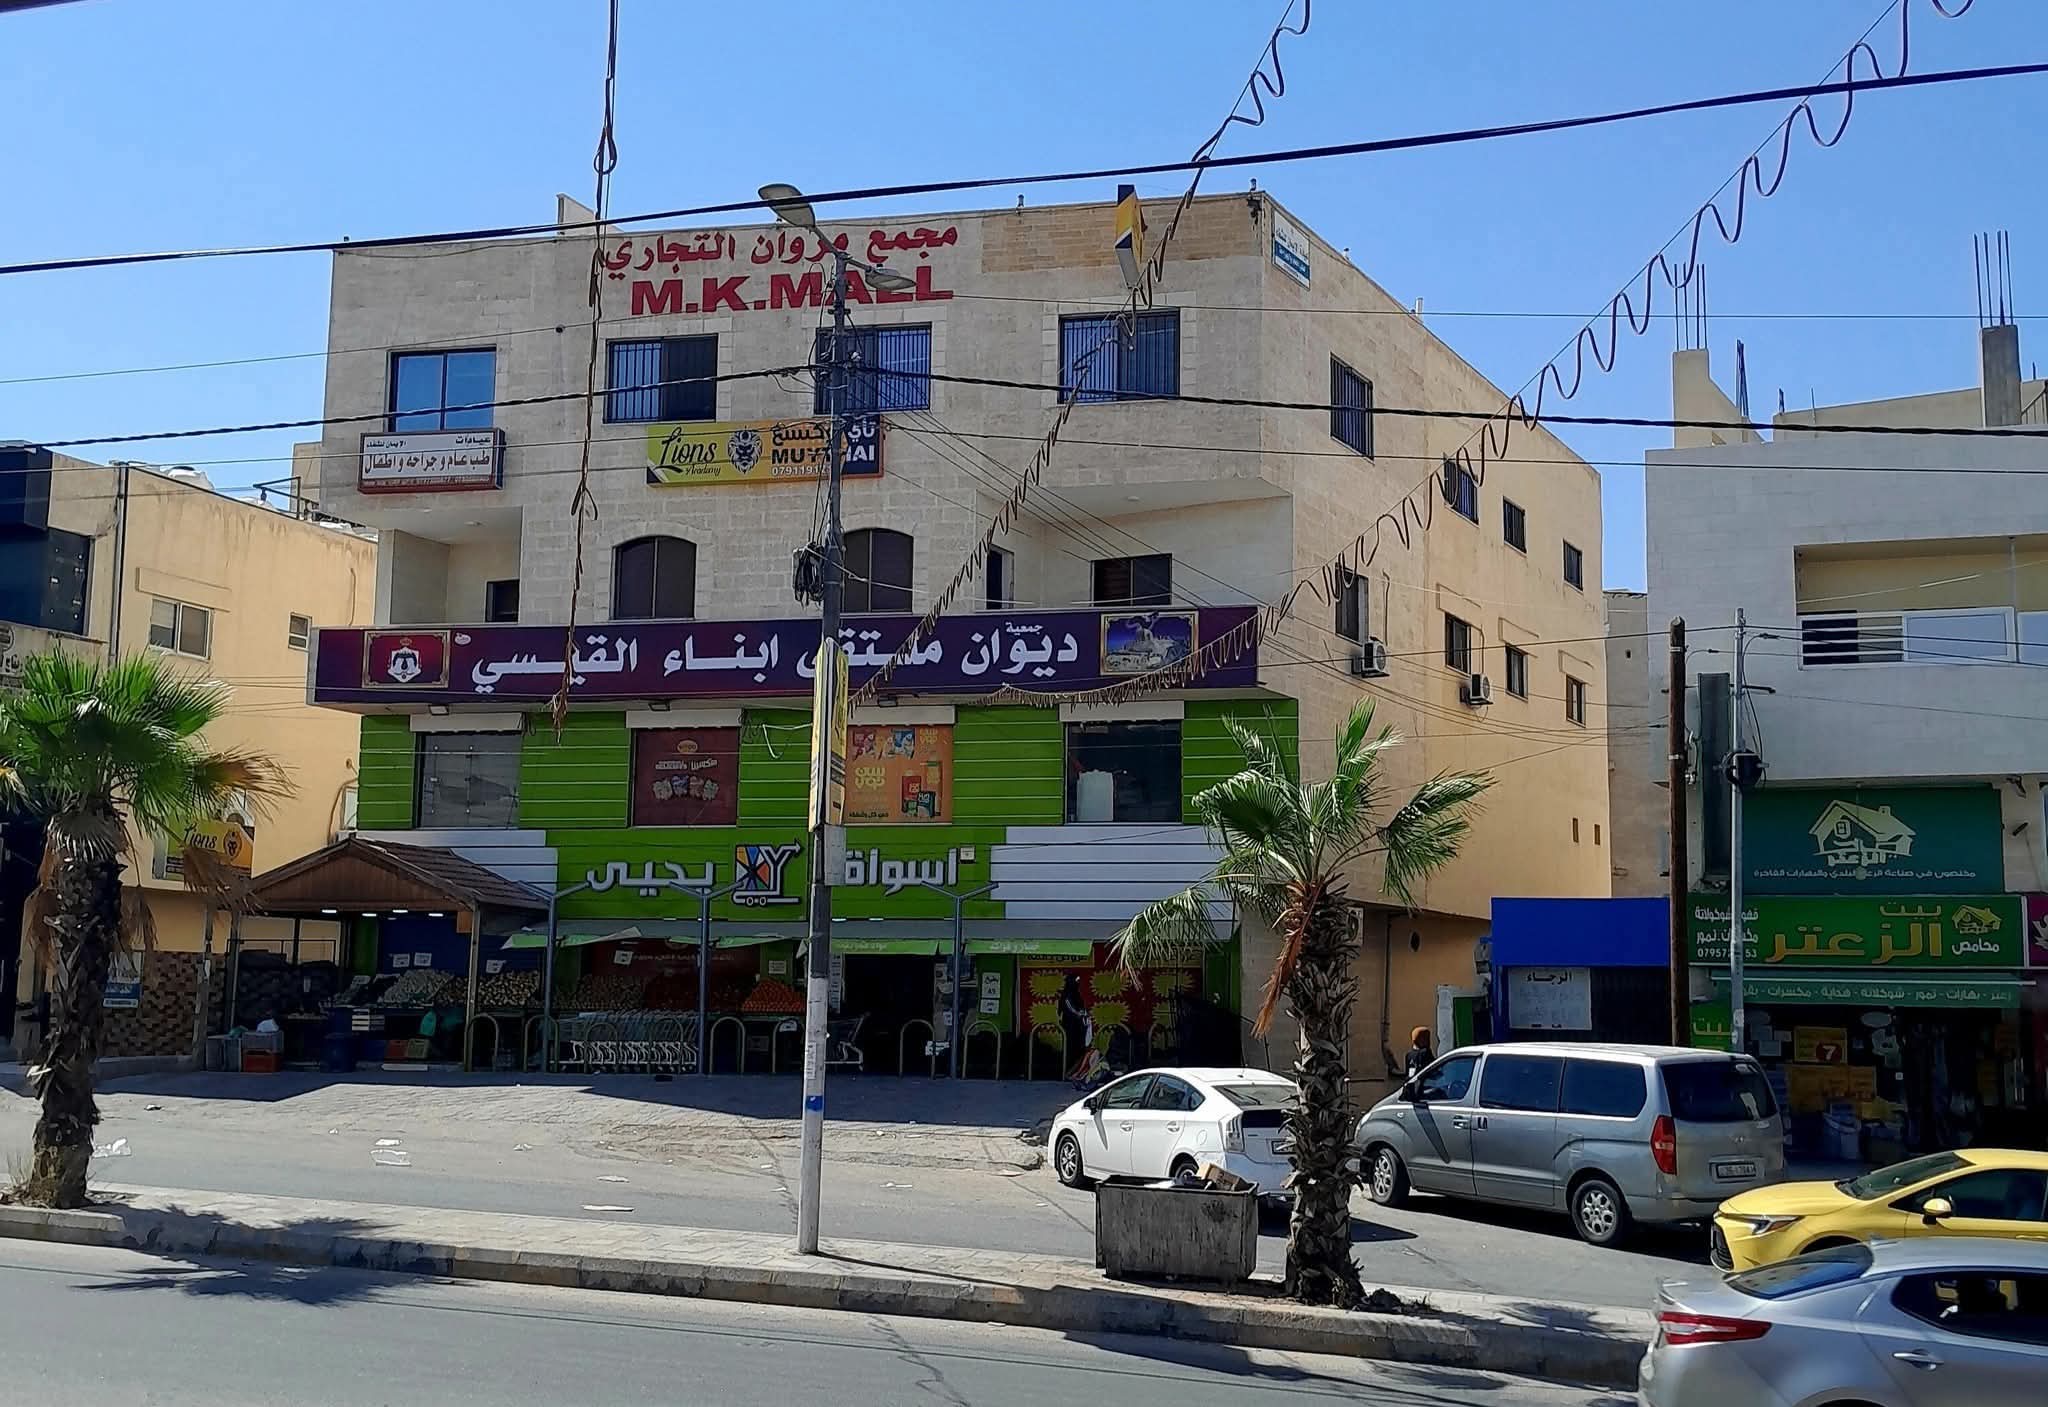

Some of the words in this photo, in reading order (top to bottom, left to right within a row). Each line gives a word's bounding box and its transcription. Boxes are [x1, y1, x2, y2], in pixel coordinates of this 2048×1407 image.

[604, 231, 736, 281] التجاري
[751, 231, 849, 265] مروان
[867, 226, 958, 264] مجمع
[447, 451, 467, 470] عام
[469, 451, 490, 470] طب
[653, 426, 718, 473] Lions
[471, 634, 638, 693] القيسي
[662, 632, 779, 682] ابناء
[961, 631, 1079, 678] ديوان
[586, 860, 715, 897] يحيى
[1915, 869, 1933, 881] في
[1879, 902, 1942, 917] بيت
[1696, 948, 1758, 958] 0795753
[1765, 922, 1943, 964] الزعتر
[1951, 937, 2000, 956] محامص
